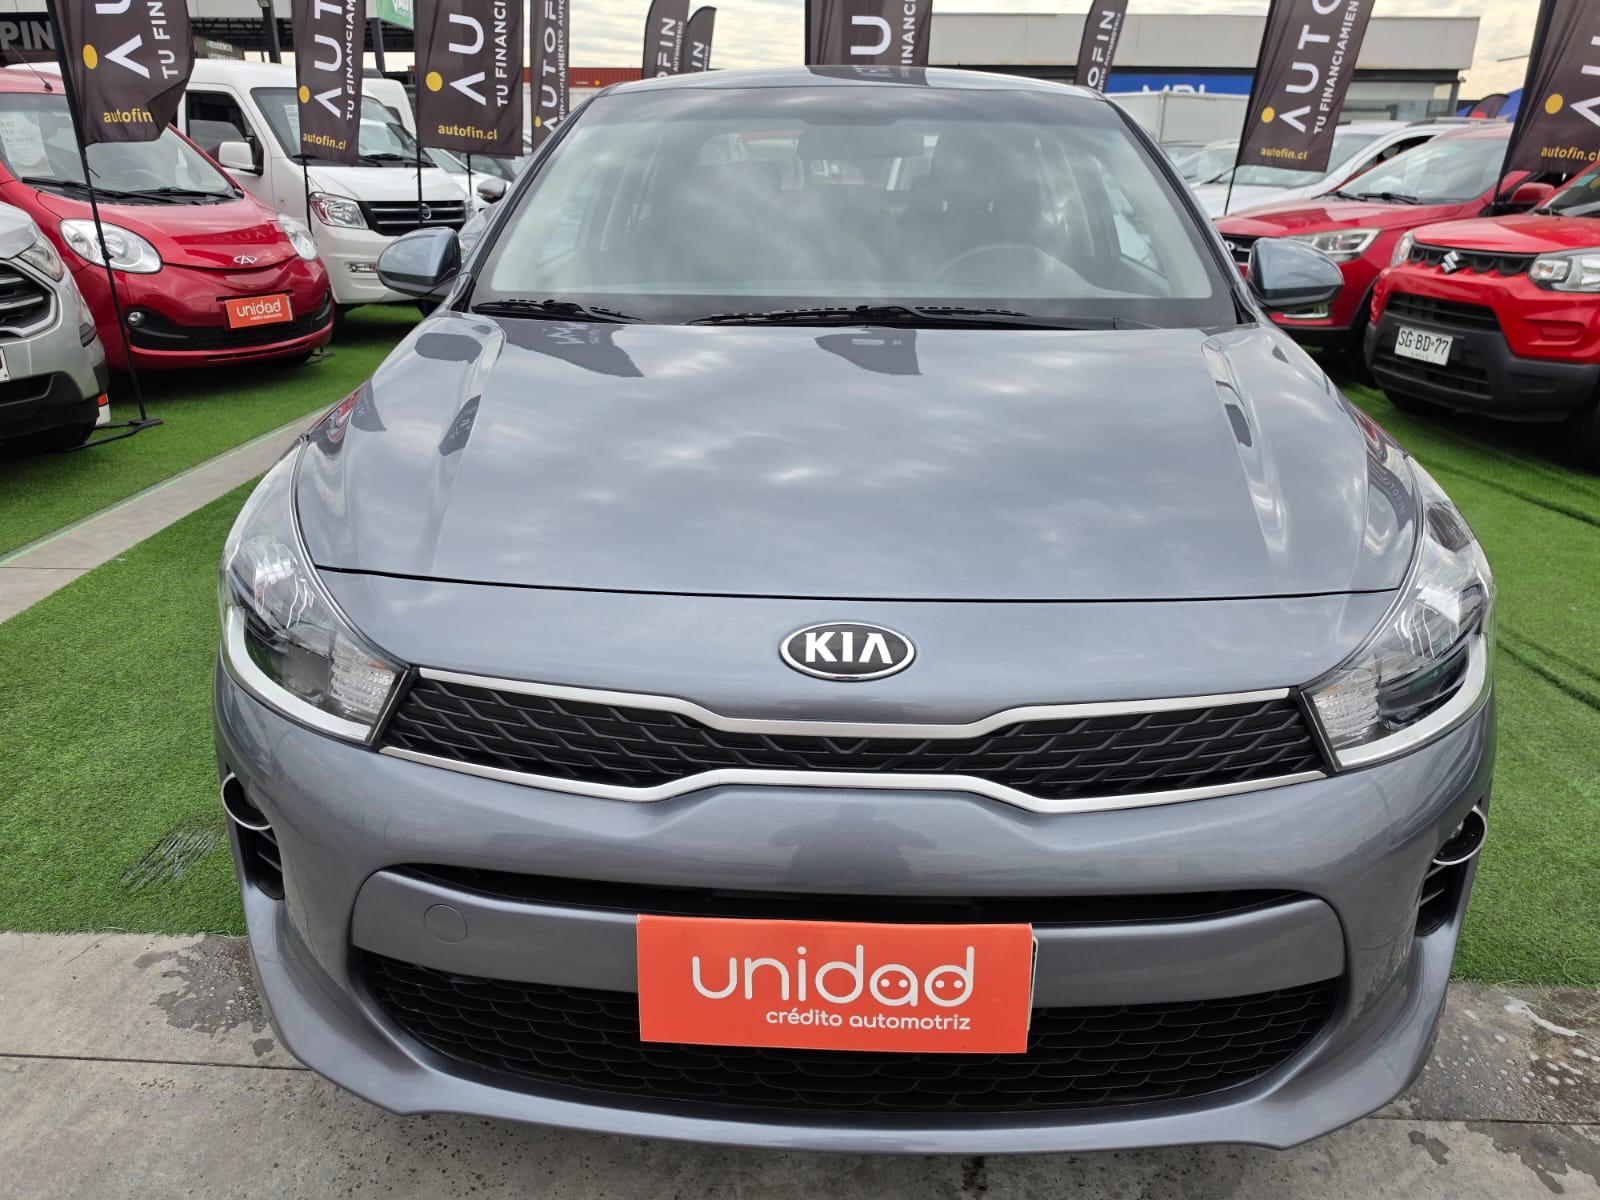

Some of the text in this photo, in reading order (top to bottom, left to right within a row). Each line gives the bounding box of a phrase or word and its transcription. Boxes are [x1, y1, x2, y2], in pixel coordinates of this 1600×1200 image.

[147, 2, 179, 79] TU FIN
[901, 0, 916, 64] INANC
[496, 85, 508, 107] TU
[346, 100, 355, 120] TU
[438, 124, 498, 140] autofin.cl
[1313, 116, 1327, 135] TU
[303, 133, 346, 151] autofin.cl
[1260, 147, 1308, 160] autofin.cl
[236, 299, 282, 317] unidad
[804, 631, 893, 664] KIA
[692, 944, 975, 1007] unidad
[766, 1007, 971, 1030] crédito automotriz
